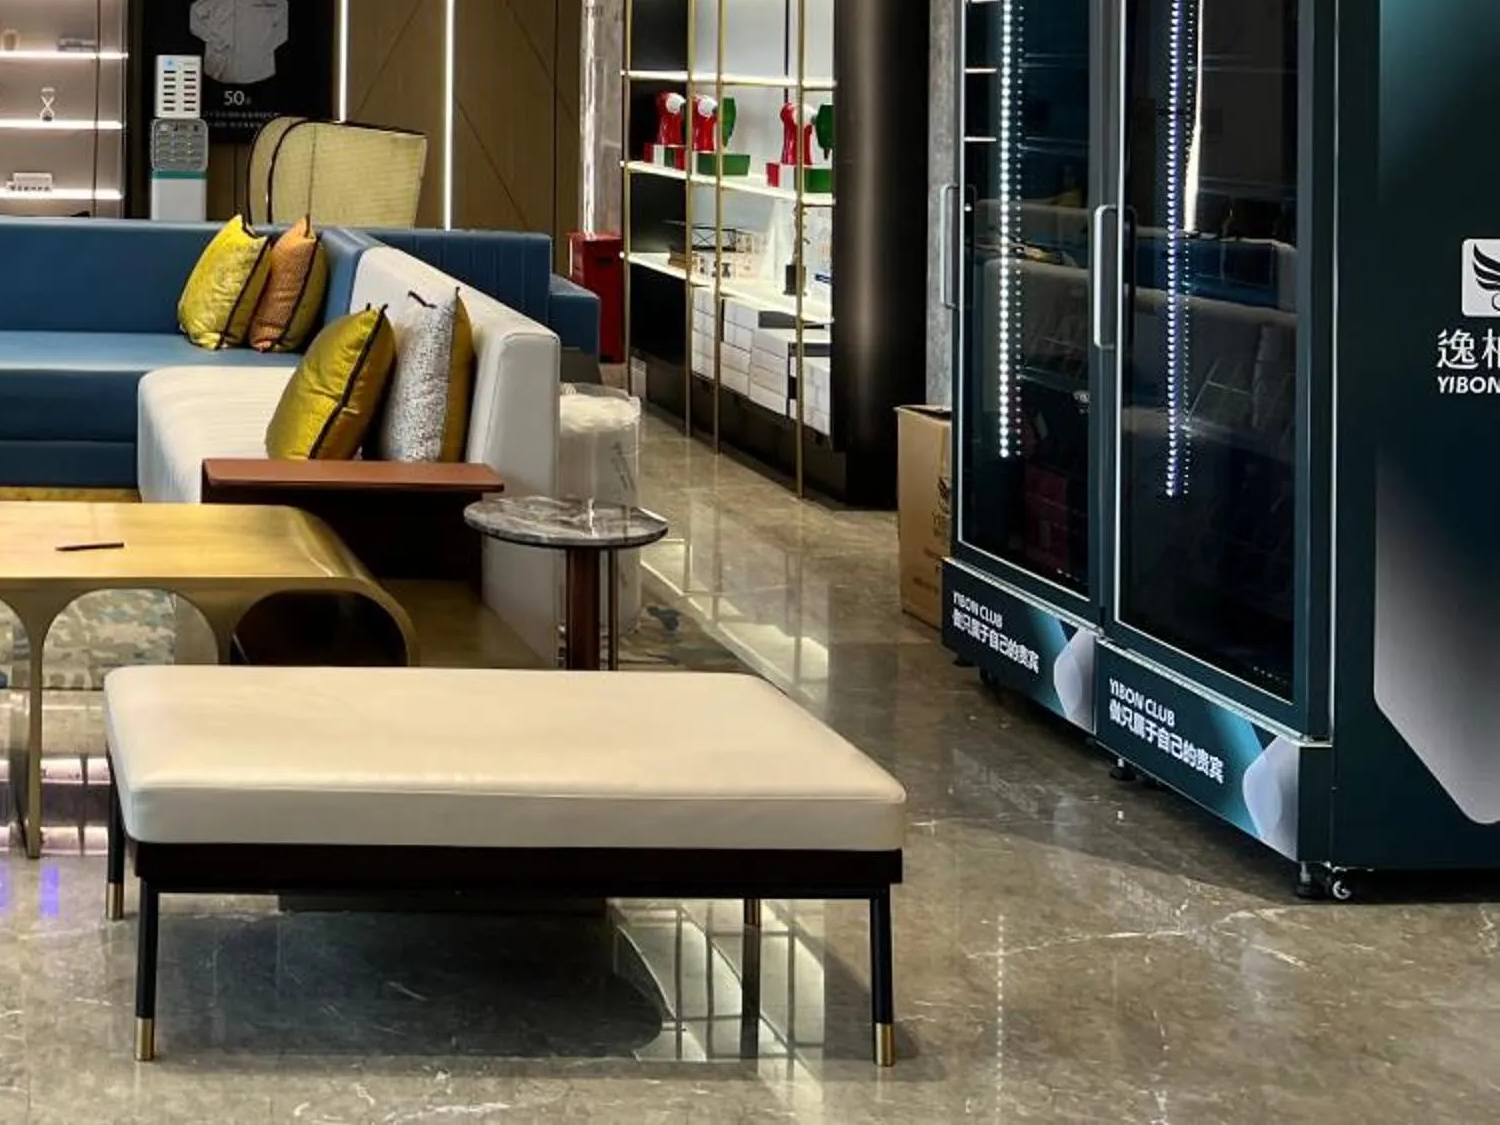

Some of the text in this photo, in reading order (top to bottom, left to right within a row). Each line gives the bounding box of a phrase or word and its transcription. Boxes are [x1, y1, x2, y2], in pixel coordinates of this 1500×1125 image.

[223, 90, 245, 106] 50
[952, 591, 1003, 629] YIBON CLUB
[1109, 678, 1176, 728] YIBON CLUB
